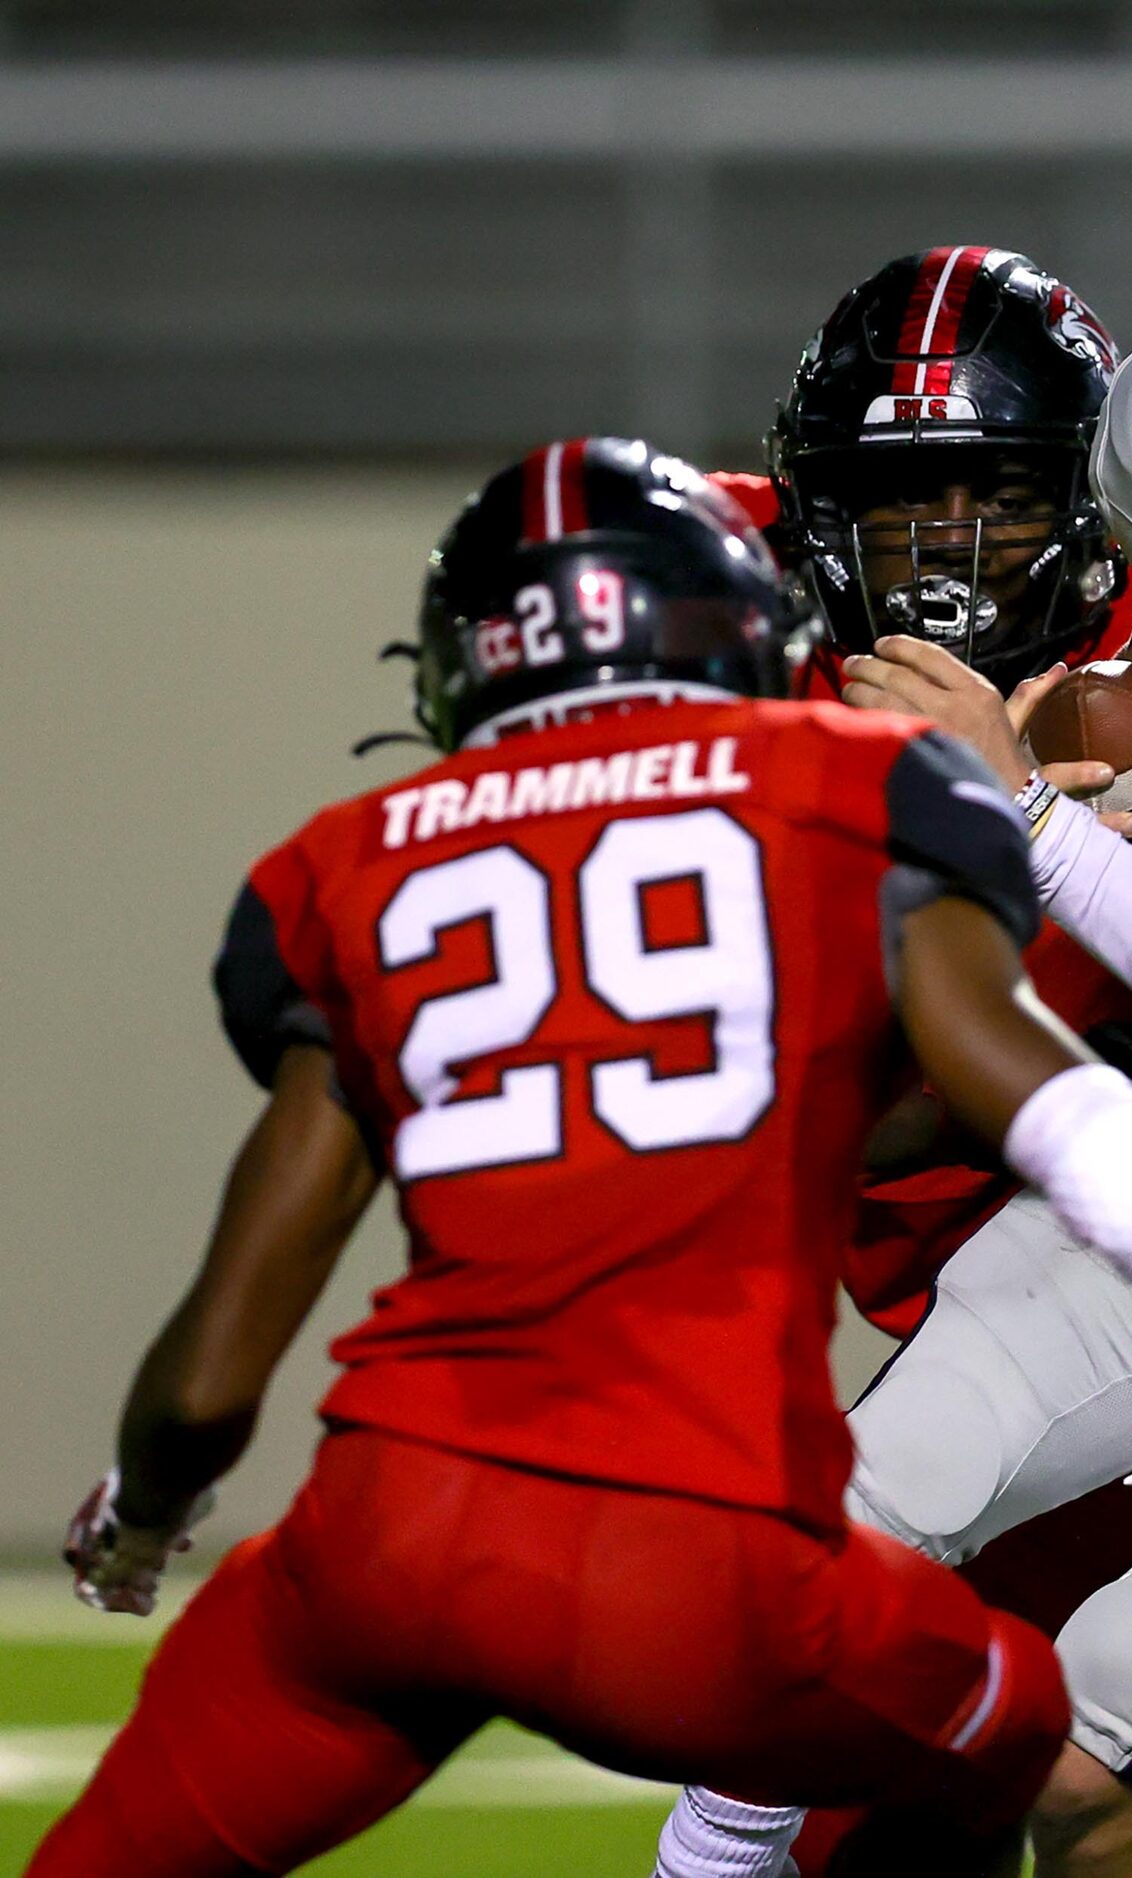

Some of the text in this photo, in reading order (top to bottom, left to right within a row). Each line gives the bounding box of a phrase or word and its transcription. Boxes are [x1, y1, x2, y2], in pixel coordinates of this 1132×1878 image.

[514, 569, 626, 668] 29
[382, 736, 751, 849] TRAMMELL
[377, 806, 778, 1184] 29
